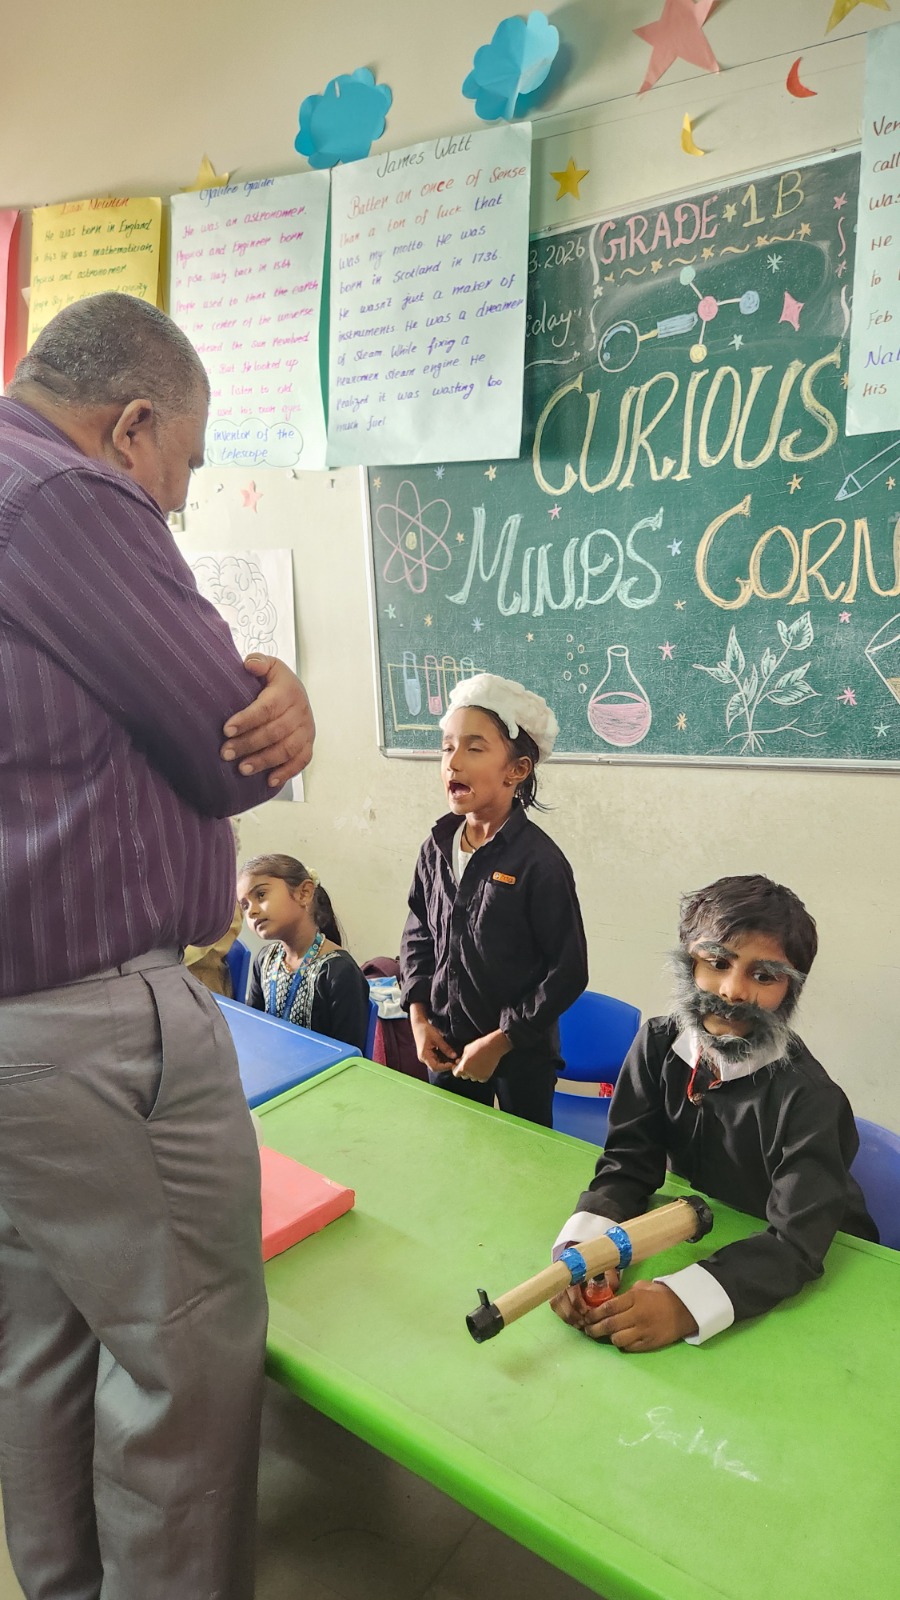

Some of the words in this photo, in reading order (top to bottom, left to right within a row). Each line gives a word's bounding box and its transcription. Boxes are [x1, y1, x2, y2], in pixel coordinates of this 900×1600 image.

[376, 151, 424, 178] James
[435, 134, 472, 160] Watt
[396, 187, 412, 205] an
[421, 178, 454, 198] once
[466, 169, 482, 188] of
[368, 227, 376, 237] a
[415, 210, 428, 226] of
[436, 205, 462, 220] luck
[474, 193, 502, 212] that
[600, 195, 720, 264] GRADE
[740, 184, 766, 228] 1
[772, 171, 804, 219] B
[60, 228, 76, 239] was
[81, 224, 102, 236] born
[107, 222, 116, 232] in
[118, 218, 153, 238] England
[182, 226, 194, 240] He
[200, 222, 220, 234] was
[226, 218, 238, 228] an
[208, 244, 227, 256] and
[280, 231, 304, 244] born
[338, 254, 360, 270] was
[369, 250, 382, 270] my
[392, 240, 424, 256] motto
[436, 232, 453, 248] He
[460, 225, 486, 241] was
[870, 235, 893, 251] He
[59, 270, 73, 282] and
[77, 264, 128, 280] astronomer
[258, 263, 268, 272] in
[339, 277, 362, 294] born
[372, 273, 382, 285] in
[392, 261, 442, 284] Scotland
[451, 255, 462, 268] in
[870, 270, 882, 288] to
[202, 297, 224, 310] used
[228, 297, 239, 308] to
[274, 286, 289, 298] the
[338, 307, 350, 321] He
[401, 292, 425, 310] just
[432, 290, 444, 300] a
[452, 278, 492, 294] maker
[500, 274, 515, 288] of
[242, 316, 253, 328] of
[259, 316, 272, 326] the
[405, 320, 419, 332] He
[426, 312, 451, 328] was
[458, 310, 466, 320] a
[475, 298, 525, 318] dreamer
[866, 309, 894, 330] Feb
[232, 341, 243, 350] the
[337, 352, 346, 366] of
[426, 337, 456, 356] fixing
[460, 335, 470, 346] a
[286, 358, 299, 372] up
[470, 353, 486, 366] He
[260, 384, 270, 394] to
[378, 392, 387, 403] it
[397, 388, 420, 402] was
[432, 381, 476, 400] wasting
[487, 374, 502, 388] too
[862, 382, 888, 398] His
[336, 418, 359, 433] much
[366, 416, 386, 432] fuel
[532, 342, 843, 496] CURIOUS
[213, 428, 250, 442] inventor
[256, 428, 269, 442] of
[276, 428, 295, 440] the
[221, 448, 268, 462] telescope
[446, 504, 665, 617] MINDS
[695, 494, 900, 610] CORN
